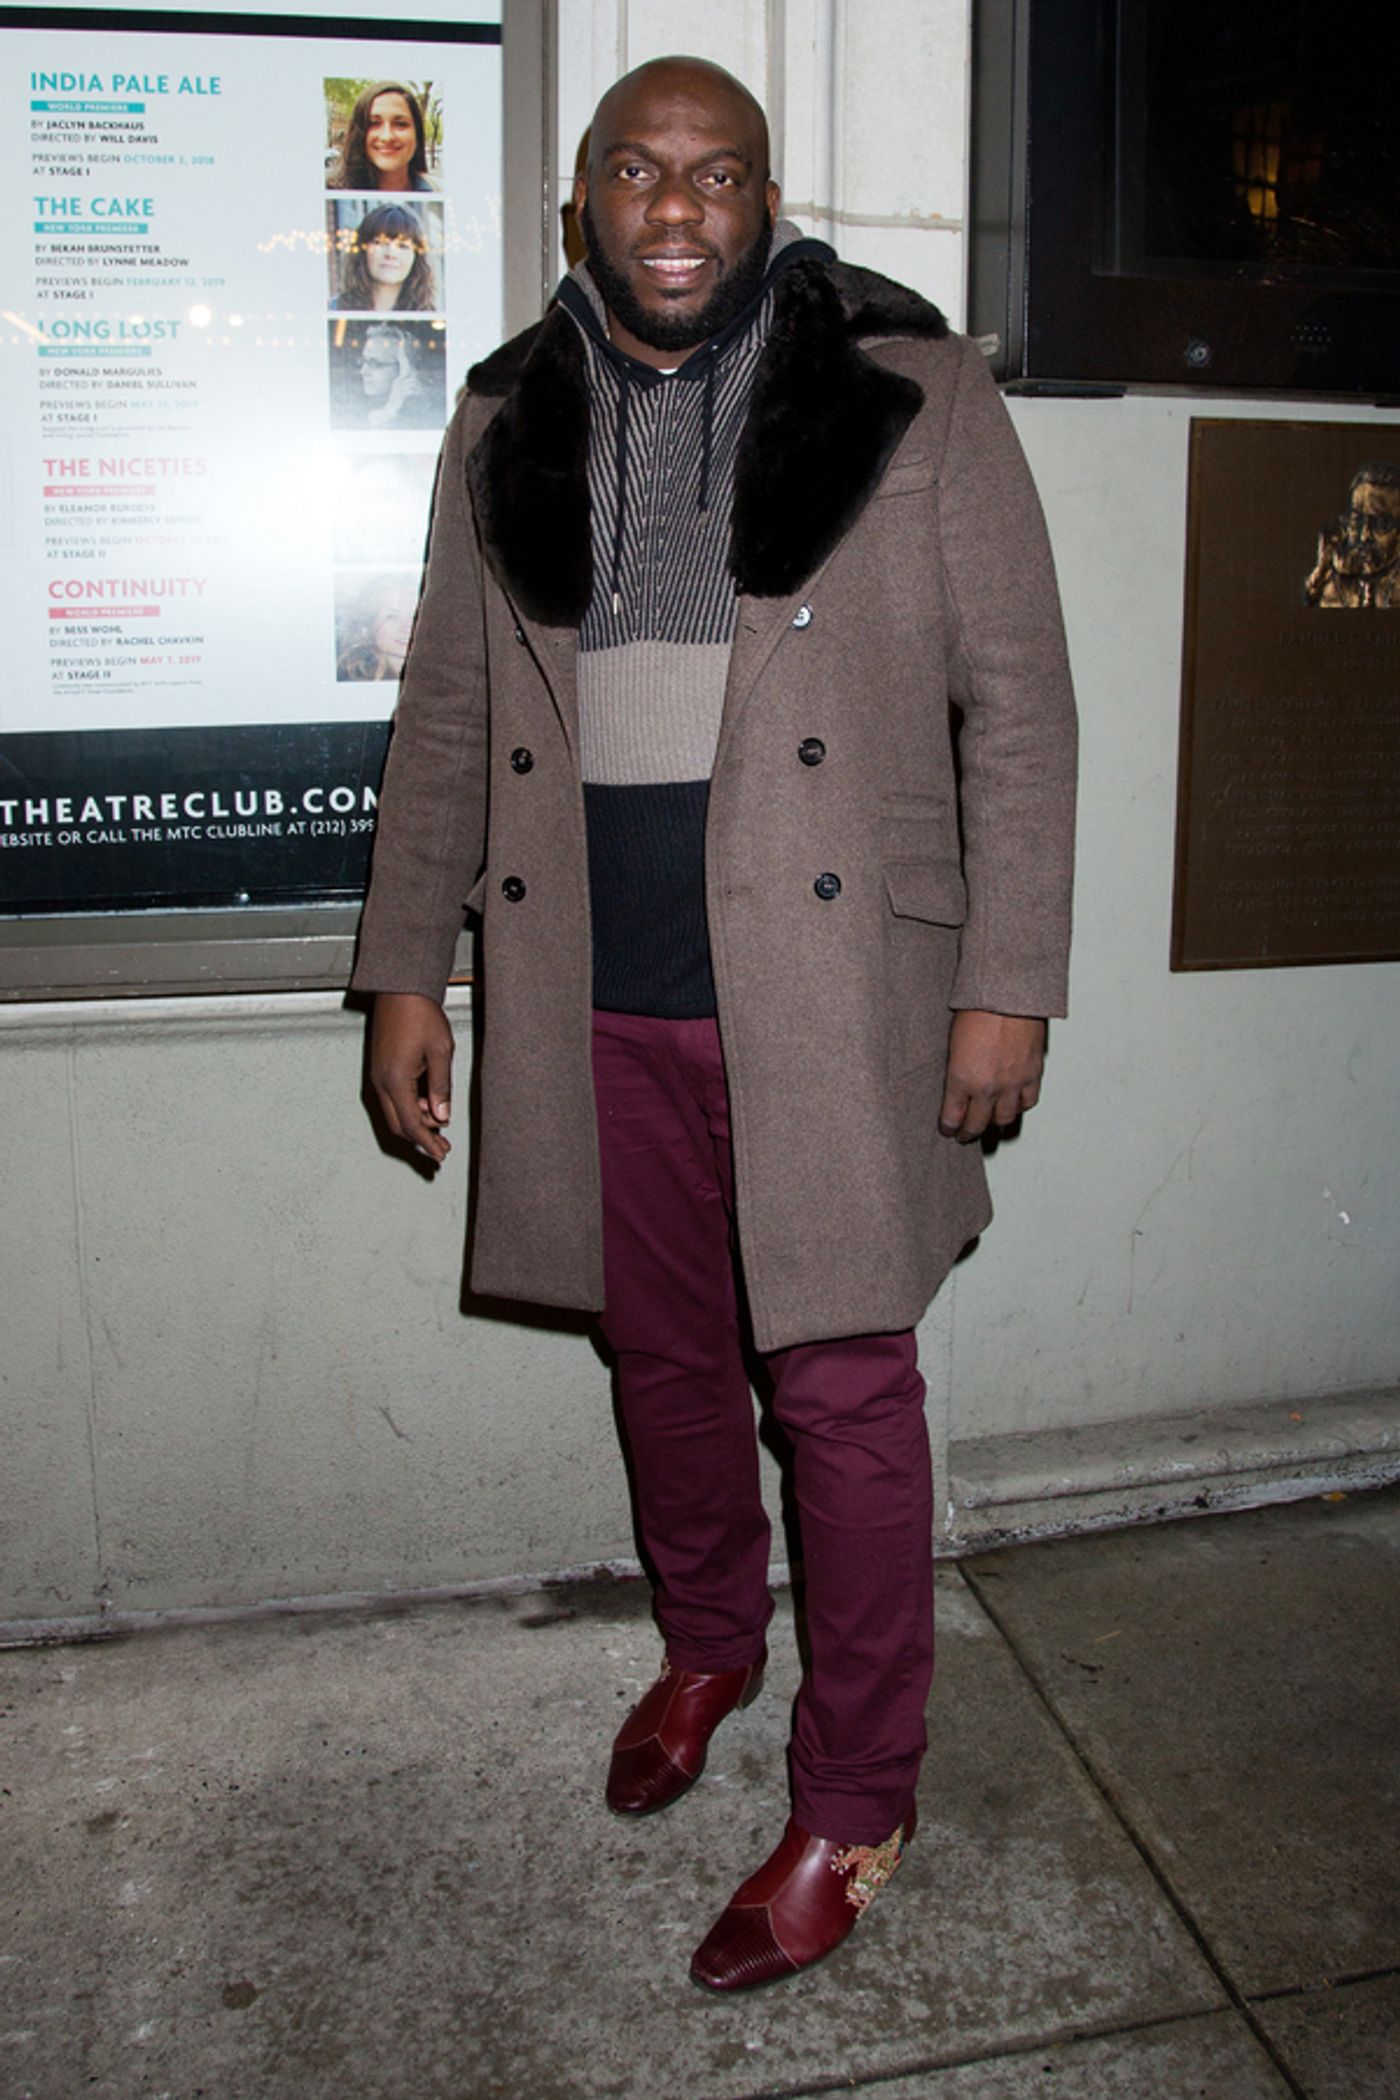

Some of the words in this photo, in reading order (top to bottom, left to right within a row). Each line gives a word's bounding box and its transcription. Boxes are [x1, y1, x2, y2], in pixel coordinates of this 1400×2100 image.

[31, 72, 103, 93] INDIA
[112, 73, 170, 94] PALE
[177, 75, 222, 95] ALE
[31, 120, 44, 130] BY
[46, 120, 85, 130] JACLYN
[88, 121, 145, 131] BACKHAUS
[31, 133, 82, 143] DIRECTED
[84, 133, 96, 143] BY
[99, 134, 125, 144] WILL
[128, 134, 159, 144] DAVIS
[32, 153, 85, 163] PREVIEWS
[87, 154, 120, 163] BEGIN
[123, 154, 176, 165] OCTOBER
[32, 167, 45, 176] AT
[48, 167, 83, 176] STAGE
[33, 196, 82, 217] THE
[90, 197, 155, 217] CAKE
[35, 244, 47, 254] BY
[88, 244, 160, 254] BRUNSTETTER
[35, 257, 85, 266] DIRECTED
[87, 257, 100, 266] BY
[102, 257, 137, 267] LYNNE
[140, 258, 190, 267] MEADOW
[35, 277, 87, 286] PREVIEWS
[91, 277, 124, 286] BEGIN
[127, 277, 182, 287] FEBRUARY
[36, 290, 49, 299] AT
[53, 290, 86, 299] STAGE
[38, 319, 111, 340] LONG
[119, 319, 182, 340] LOST
[39, 368, 51, 377] BY
[54, 367, 99, 376] DONALD
[39, 380, 89, 390] DIRECTED
[91, 380, 103, 389] BY
[106, 380, 144, 389] DANIEL
[39, 400, 92, 409] PREVIEWS
[95, 400, 127, 409] BEGIN
[130, 400, 153, 409] MAY
[40, 413, 53, 422] AT
[56, 413, 91, 423] STAGE
[42, 458, 91, 477] THE
[99, 457, 208, 477] NICETIES
[44, 504, 56, 513] BY
[59, 504, 107, 513] ELEANOR
[44, 517, 94, 526] DIRECTED
[96, 517, 108, 525] BY
[44, 537, 96, 546] PREVIEWS
[99, 536, 132, 545] BEGIN
[46, 550, 59, 559] AT
[62, 549, 96, 559] STAGE
[48, 578, 207, 600] CONTINUITY
[49, 627, 61, 635] BY
[64, 626, 89, 635] BESS
[91, 625, 123, 634] WOHL
[49, 638, 98, 648] DIRECTED
[100, 638, 113, 647] BY
[116, 637, 156, 646] RACHEL
[50, 658, 102, 667] PREVIEWS
[105, 657, 137, 666] BEGIN
[140, 656, 163, 665] MAY
[52, 671, 64, 680] AT
[67, 671, 100, 680] STAGE
[57, 829, 83, 845] OR
[86, 828, 128, 844] CALL
[130, 827, 163, 843] THE
[165, 825, 203, 841] MTC
[205, 822, 283, 840] CLUBLINE
[286, 821, 308, 836] AT
[310, 818, 346, 838] (212)
